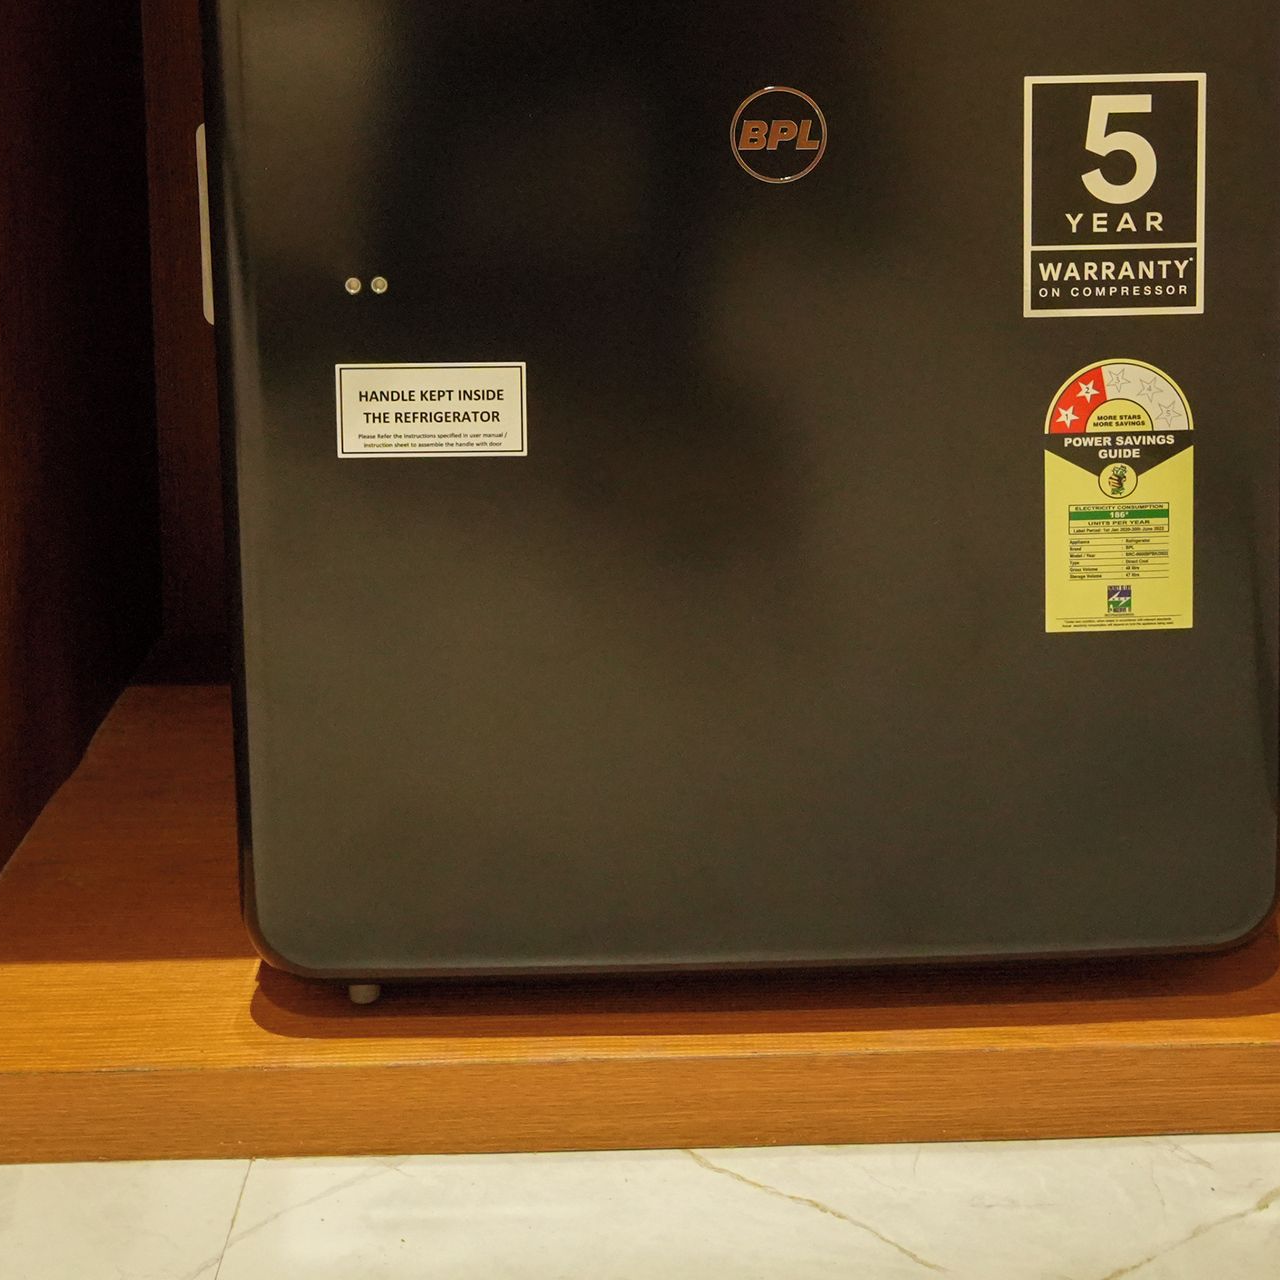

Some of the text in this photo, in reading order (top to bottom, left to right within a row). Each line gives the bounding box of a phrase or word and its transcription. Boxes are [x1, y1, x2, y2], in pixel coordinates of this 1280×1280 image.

[738, 119, 820, 150] BPL
[1081, 94, 1157, 205] 5
[1064, 212, 1164, 233] YEAR
[1038, 285, 1188, 298] ON COMPRESSOR
[358, 389, 504, 402] HANDLE KEPT INSIDE
[363, 410, 500, 424] THE REFRIGERATOR
[1064, 434, 1175, 448] POWER SAVINGS
[1098, 448, 1140, 459] GUIDE
